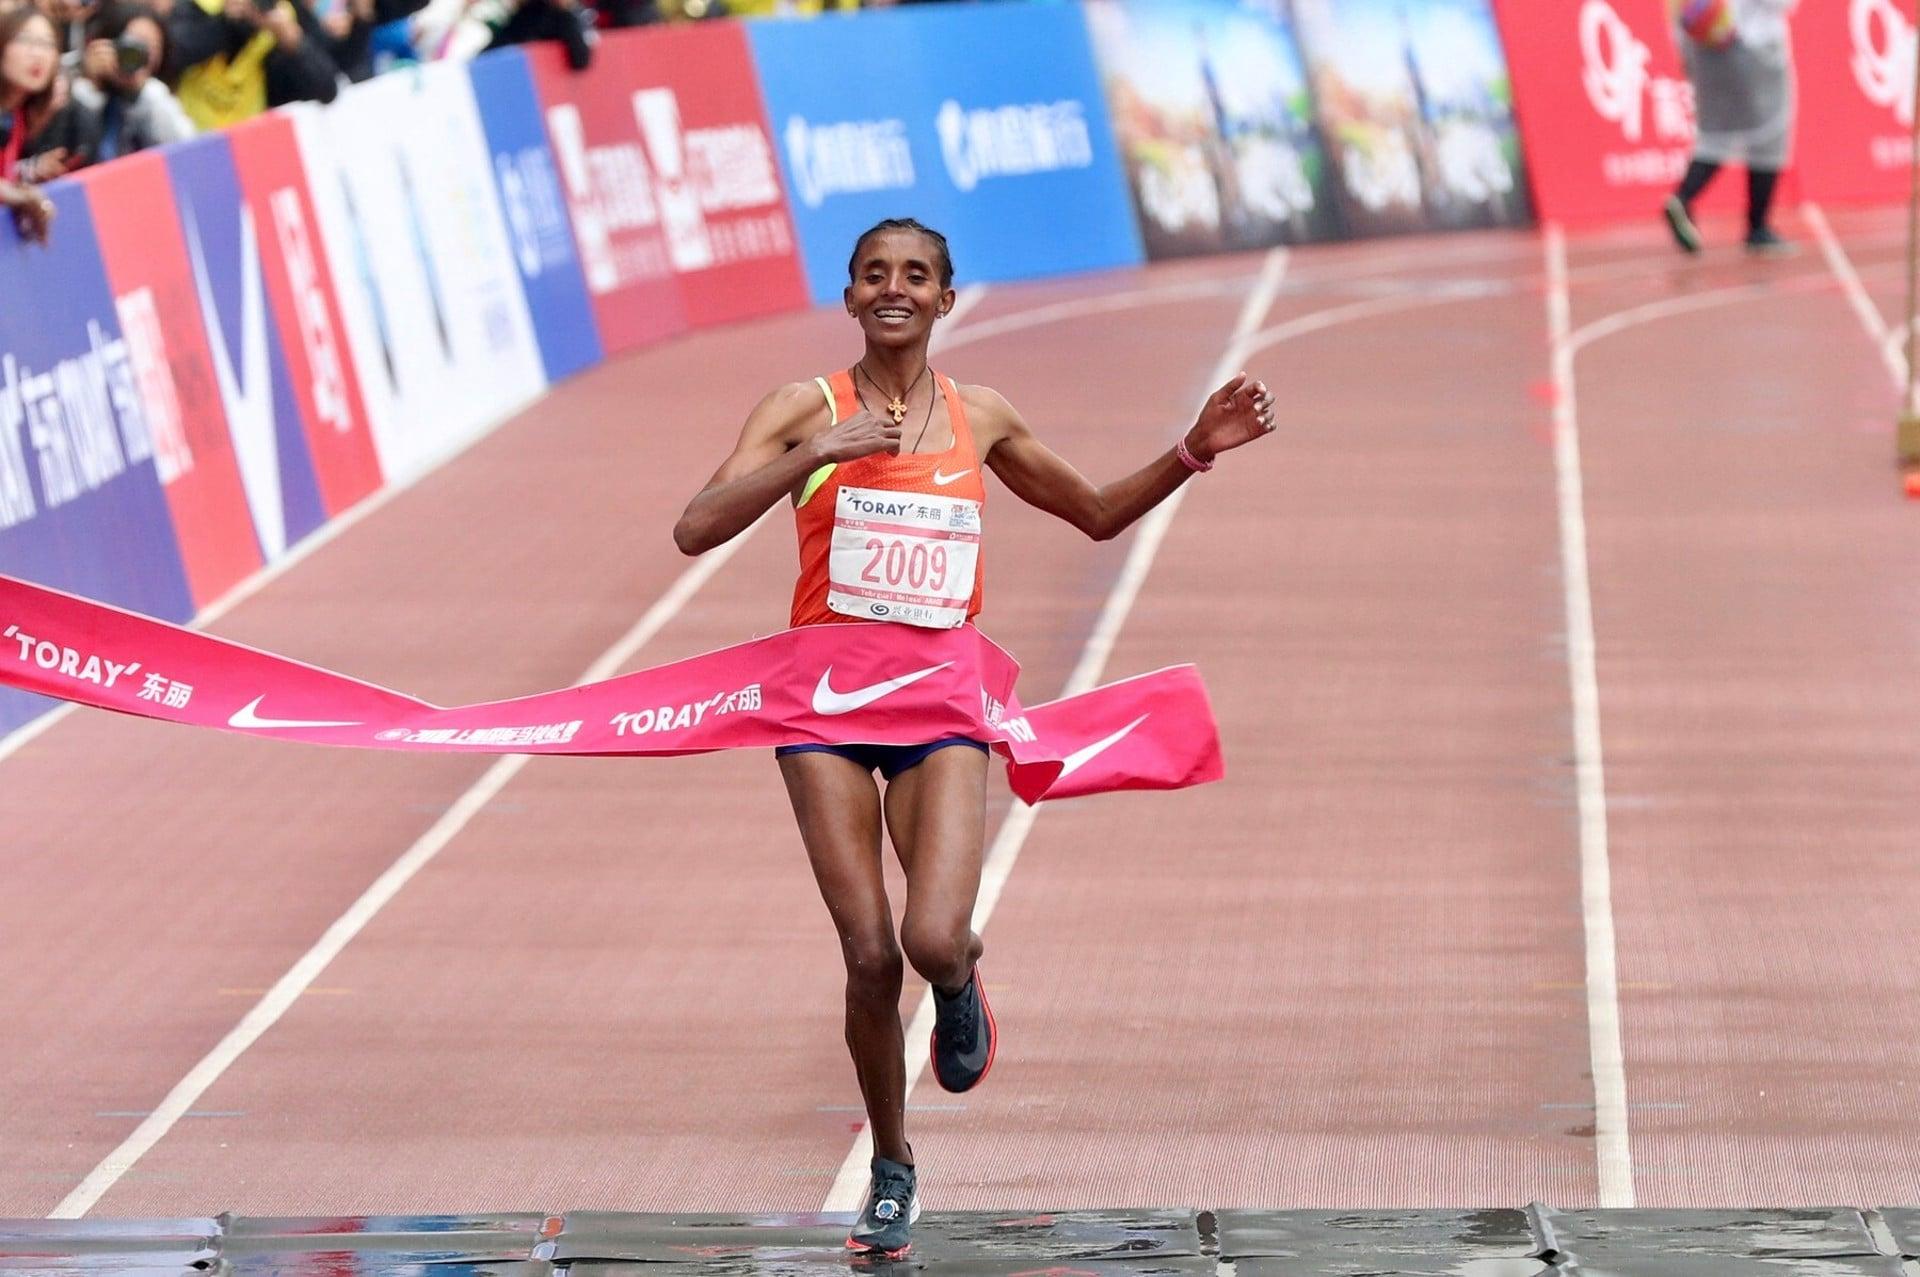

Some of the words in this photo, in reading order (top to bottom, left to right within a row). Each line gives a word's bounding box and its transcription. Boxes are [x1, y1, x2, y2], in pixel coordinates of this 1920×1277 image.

[916, 506, 941, 520] 东丽
[861, 538, 947, 591] 2009
[136, 672, 194, 709] 东丽
